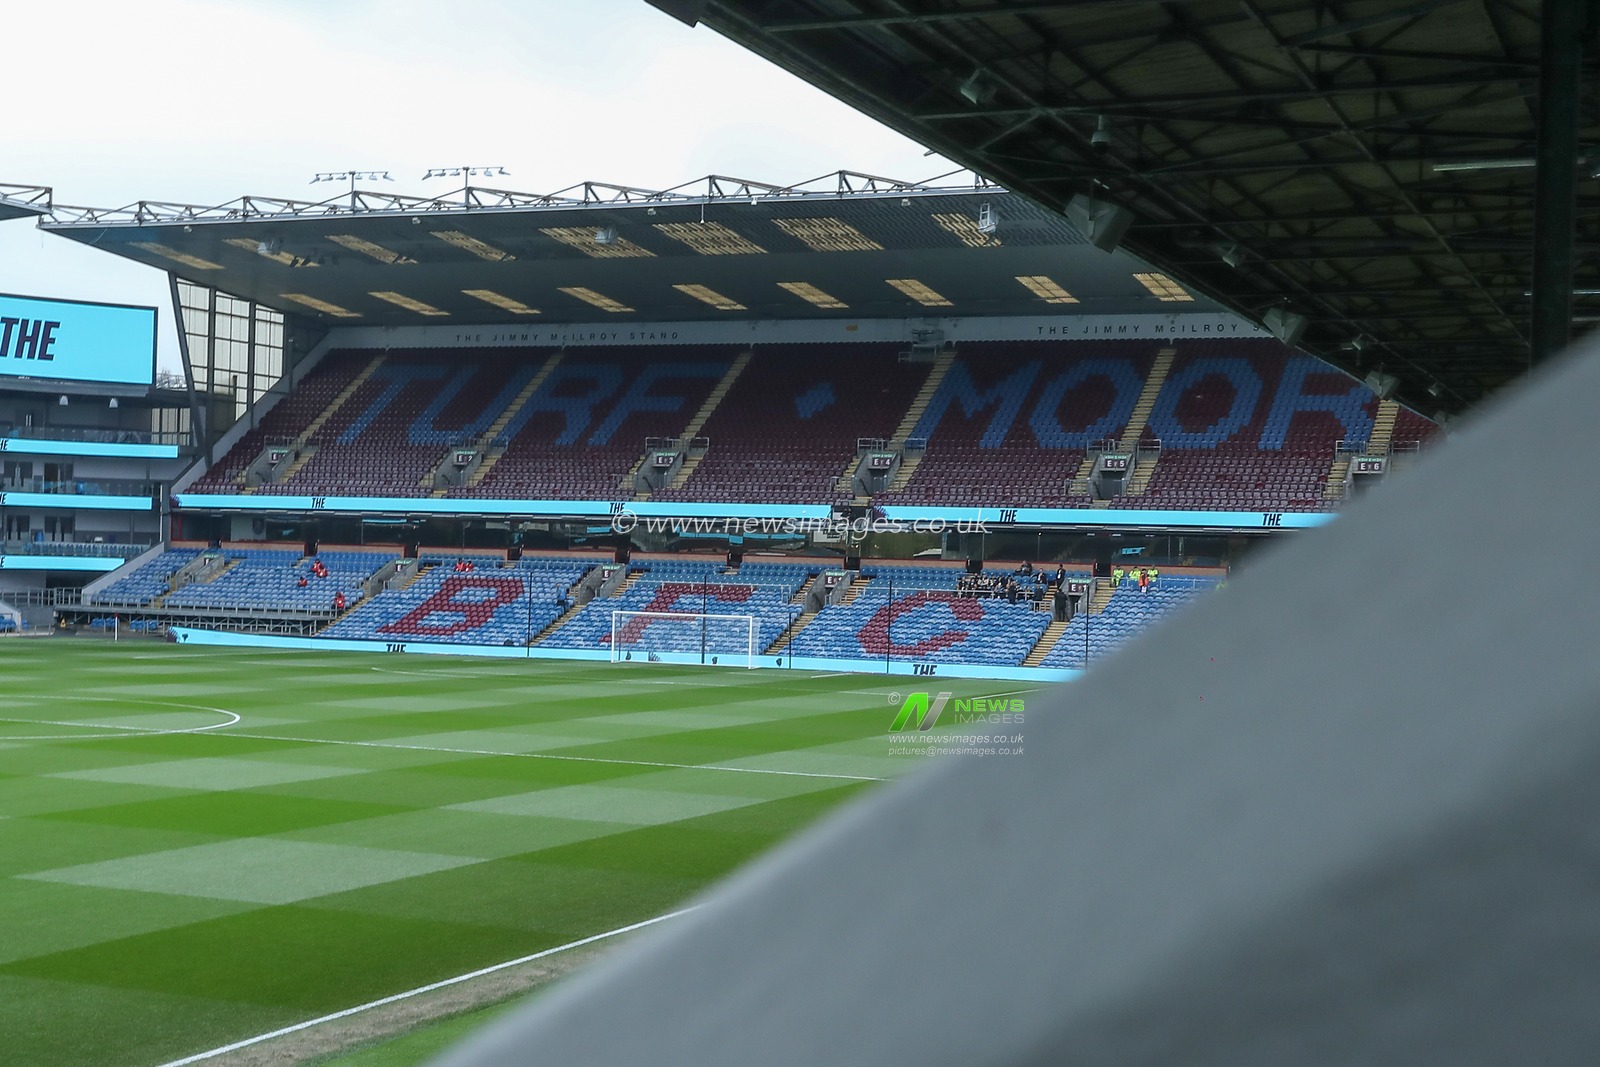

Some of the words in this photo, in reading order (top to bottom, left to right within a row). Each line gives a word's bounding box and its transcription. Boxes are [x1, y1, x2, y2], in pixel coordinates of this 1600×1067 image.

[1037, 326, 1069, 335] THE
[1083, 325, 1140, 334] JIMMY
[1155, 324, 1238, 333] McILROY
[0, 317, 61, 361] THE
[456, 334, 481, 342] THE
[492, 333, 539, 342] JIMMY
[629, 332, 678, 340] STAND
[335, 362, 735, 446] TURF
[904, 358, 1374, 450] MOOR
[311, 497, 326, 509] THE
[609, 502, 626, 514] THE
[999, 509, 1018, 523] THE
[1262, 513, 1283, 526] THE
